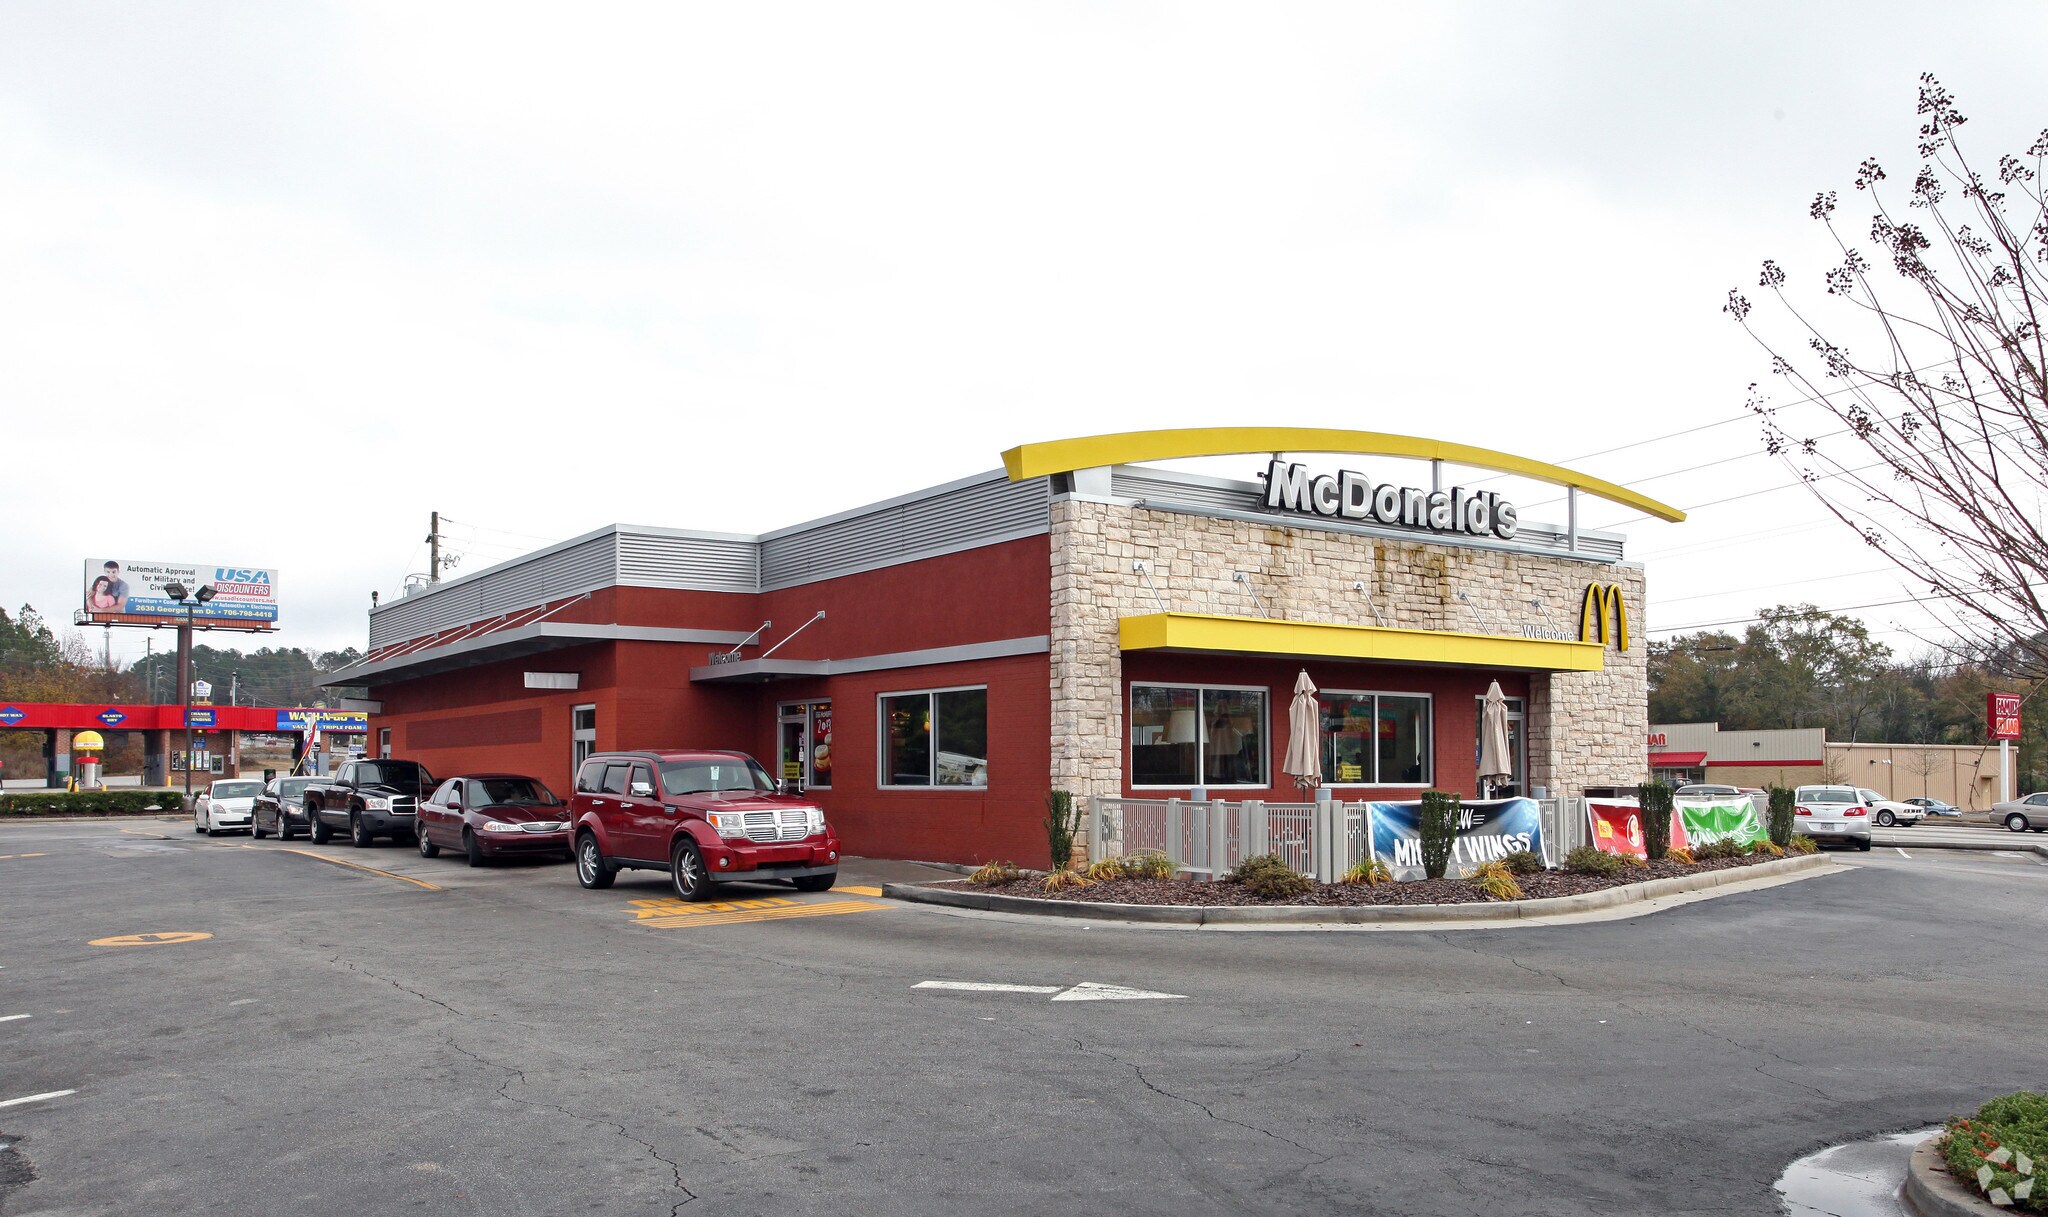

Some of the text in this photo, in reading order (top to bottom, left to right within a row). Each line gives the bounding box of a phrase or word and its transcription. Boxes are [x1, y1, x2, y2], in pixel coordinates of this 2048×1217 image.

[1265, 460, 1518, 540] McDonald's
[127, 565, 163, 574] Automatic
[215, 568, 270, 584] USA
[154, 576, 180, 584] Military
[217, 583, 269, 595] DISCOUNTERS
[157, 606, 204, 614] Georgetwn
[1522, 624, 1574, 641] Welcome
[708, 651, 741, 665] Welcome
[1463, 832, 1531, 863] WINGS
